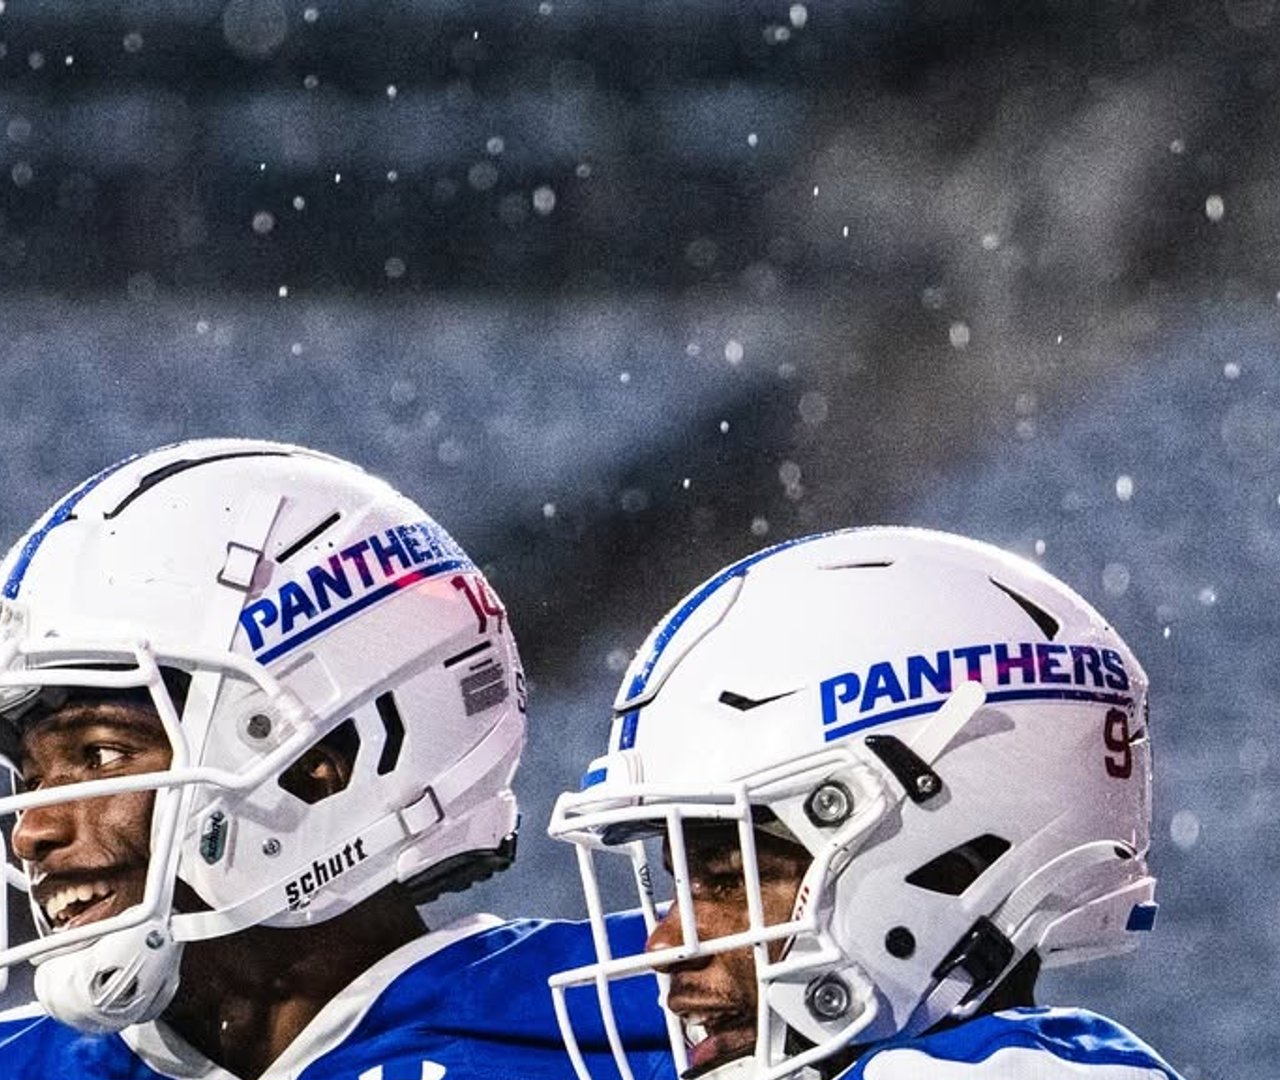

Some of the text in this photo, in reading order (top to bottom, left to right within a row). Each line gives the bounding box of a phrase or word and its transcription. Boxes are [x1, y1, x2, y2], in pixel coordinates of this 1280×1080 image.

[239, 523, 458, 651] PANTHE
[820, 643, 1129, 726] PANTHERS
[1104, 707, 1133, 780] 9
[286, 837, 369, 904] schutt
